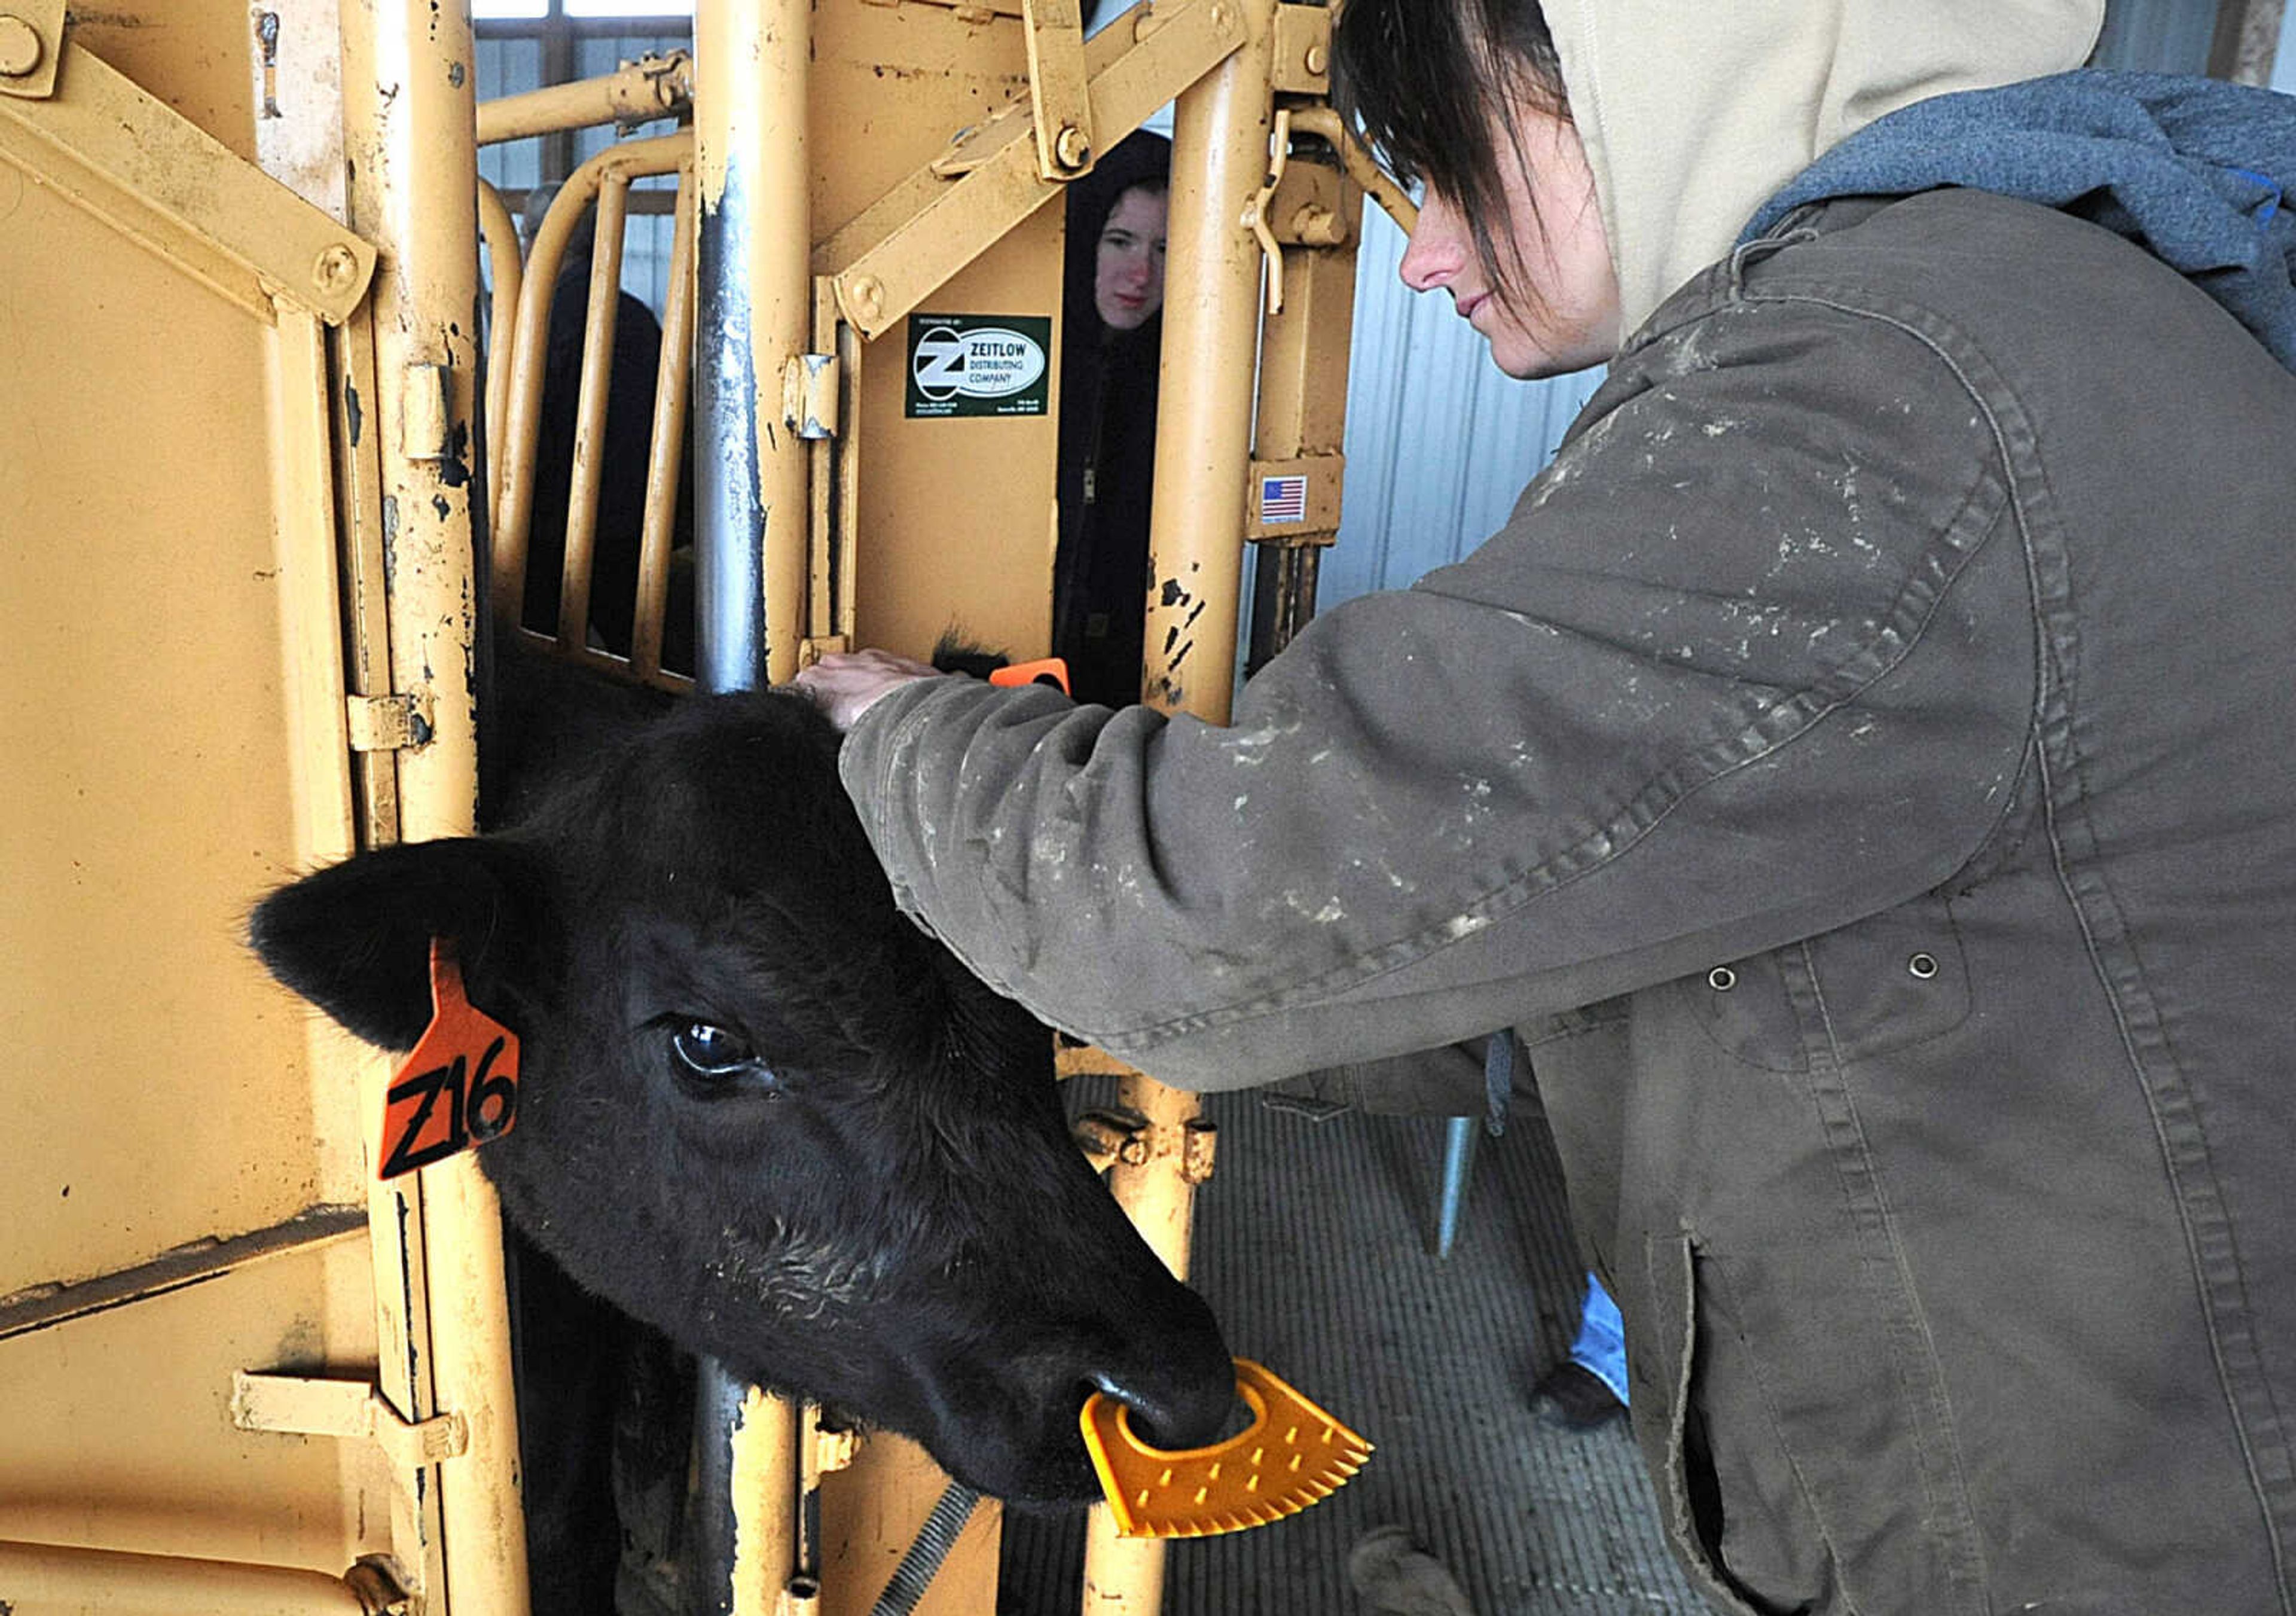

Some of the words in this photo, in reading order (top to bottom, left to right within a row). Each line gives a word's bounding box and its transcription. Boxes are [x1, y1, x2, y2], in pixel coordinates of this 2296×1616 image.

[970, 343, 1027, 356] ZEITLOW
[970, 360, 1023, 370] DISTRIBUTING
[969, 373, 1011, 383] COMPANY
[381, 1035, 516, 1178] Z16
